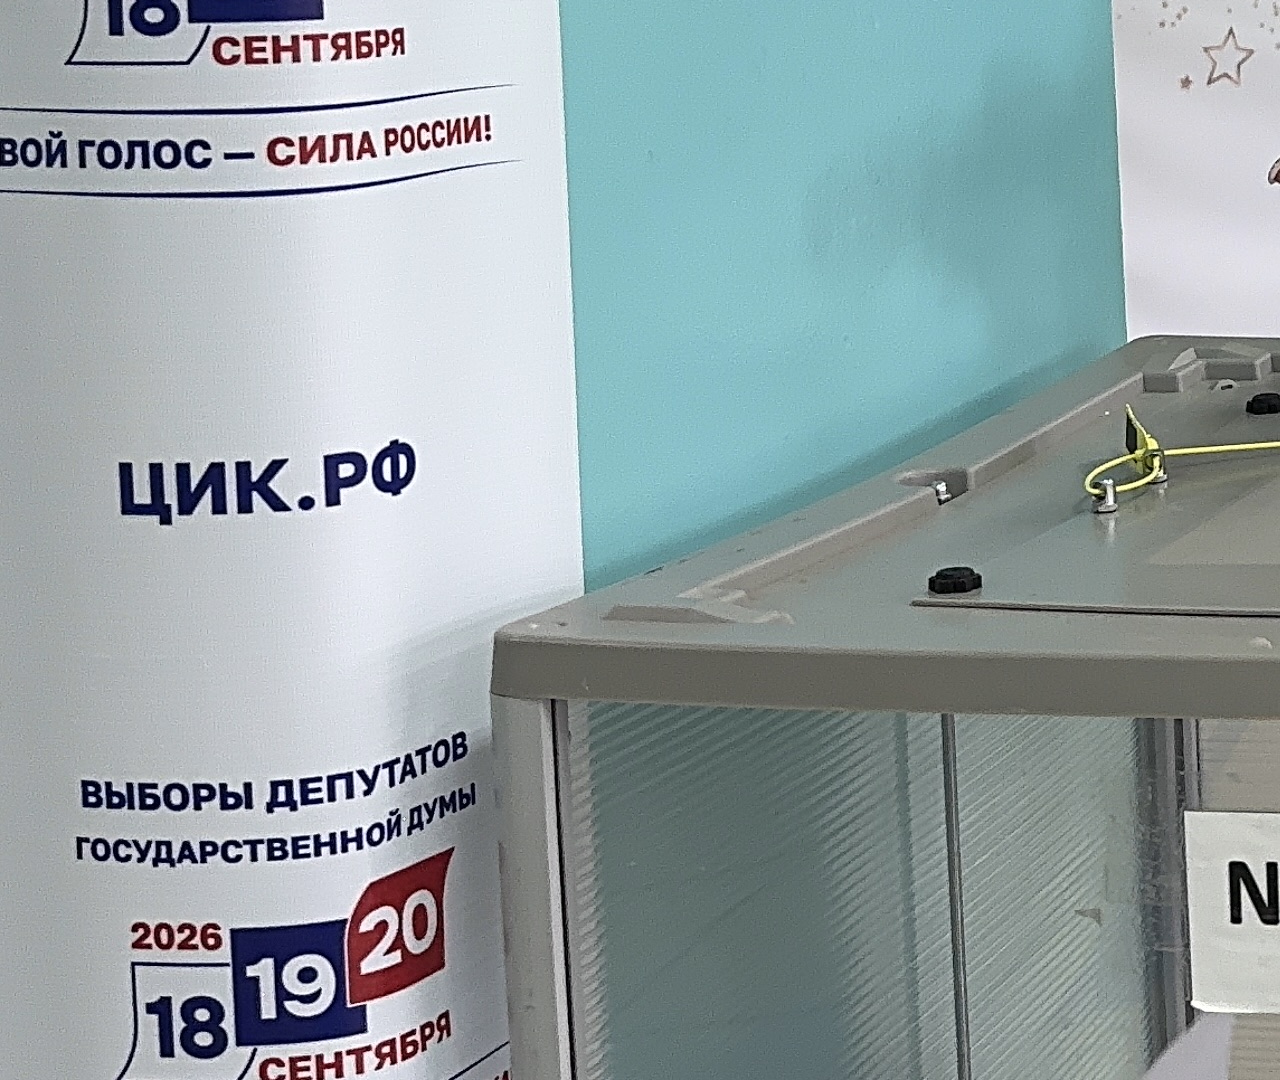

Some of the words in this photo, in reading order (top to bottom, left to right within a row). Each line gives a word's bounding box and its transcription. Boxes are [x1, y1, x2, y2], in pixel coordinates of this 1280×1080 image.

[213, 28, 404, 65] СЕНТЯБРЯ
[78, 140, 212, 169] ГОЛОС
[267, 131, 377, 166] СИЛА
[385, 115, 491, 156] РОССИИ!
[119, 439, 415, 525] ЦИК.РФ
[81, 780, 253, 811] ВЫБОРЫ
[266, 731, 469, 813] ДЕПУТАТОВ
[76, 808, 401, 867] ГОСУДАРСТВЕННОЙ
[407, 783, 476, 832] ДУМЫ
[131, 922, 222, 950] 2026
[146, 996, 228, 1059] 18
[246, 954, 335, 1019] 19
[359, 889, 438, 975] 20
[258, 1009, 452, 1080] СЕНТЯБРЯ
